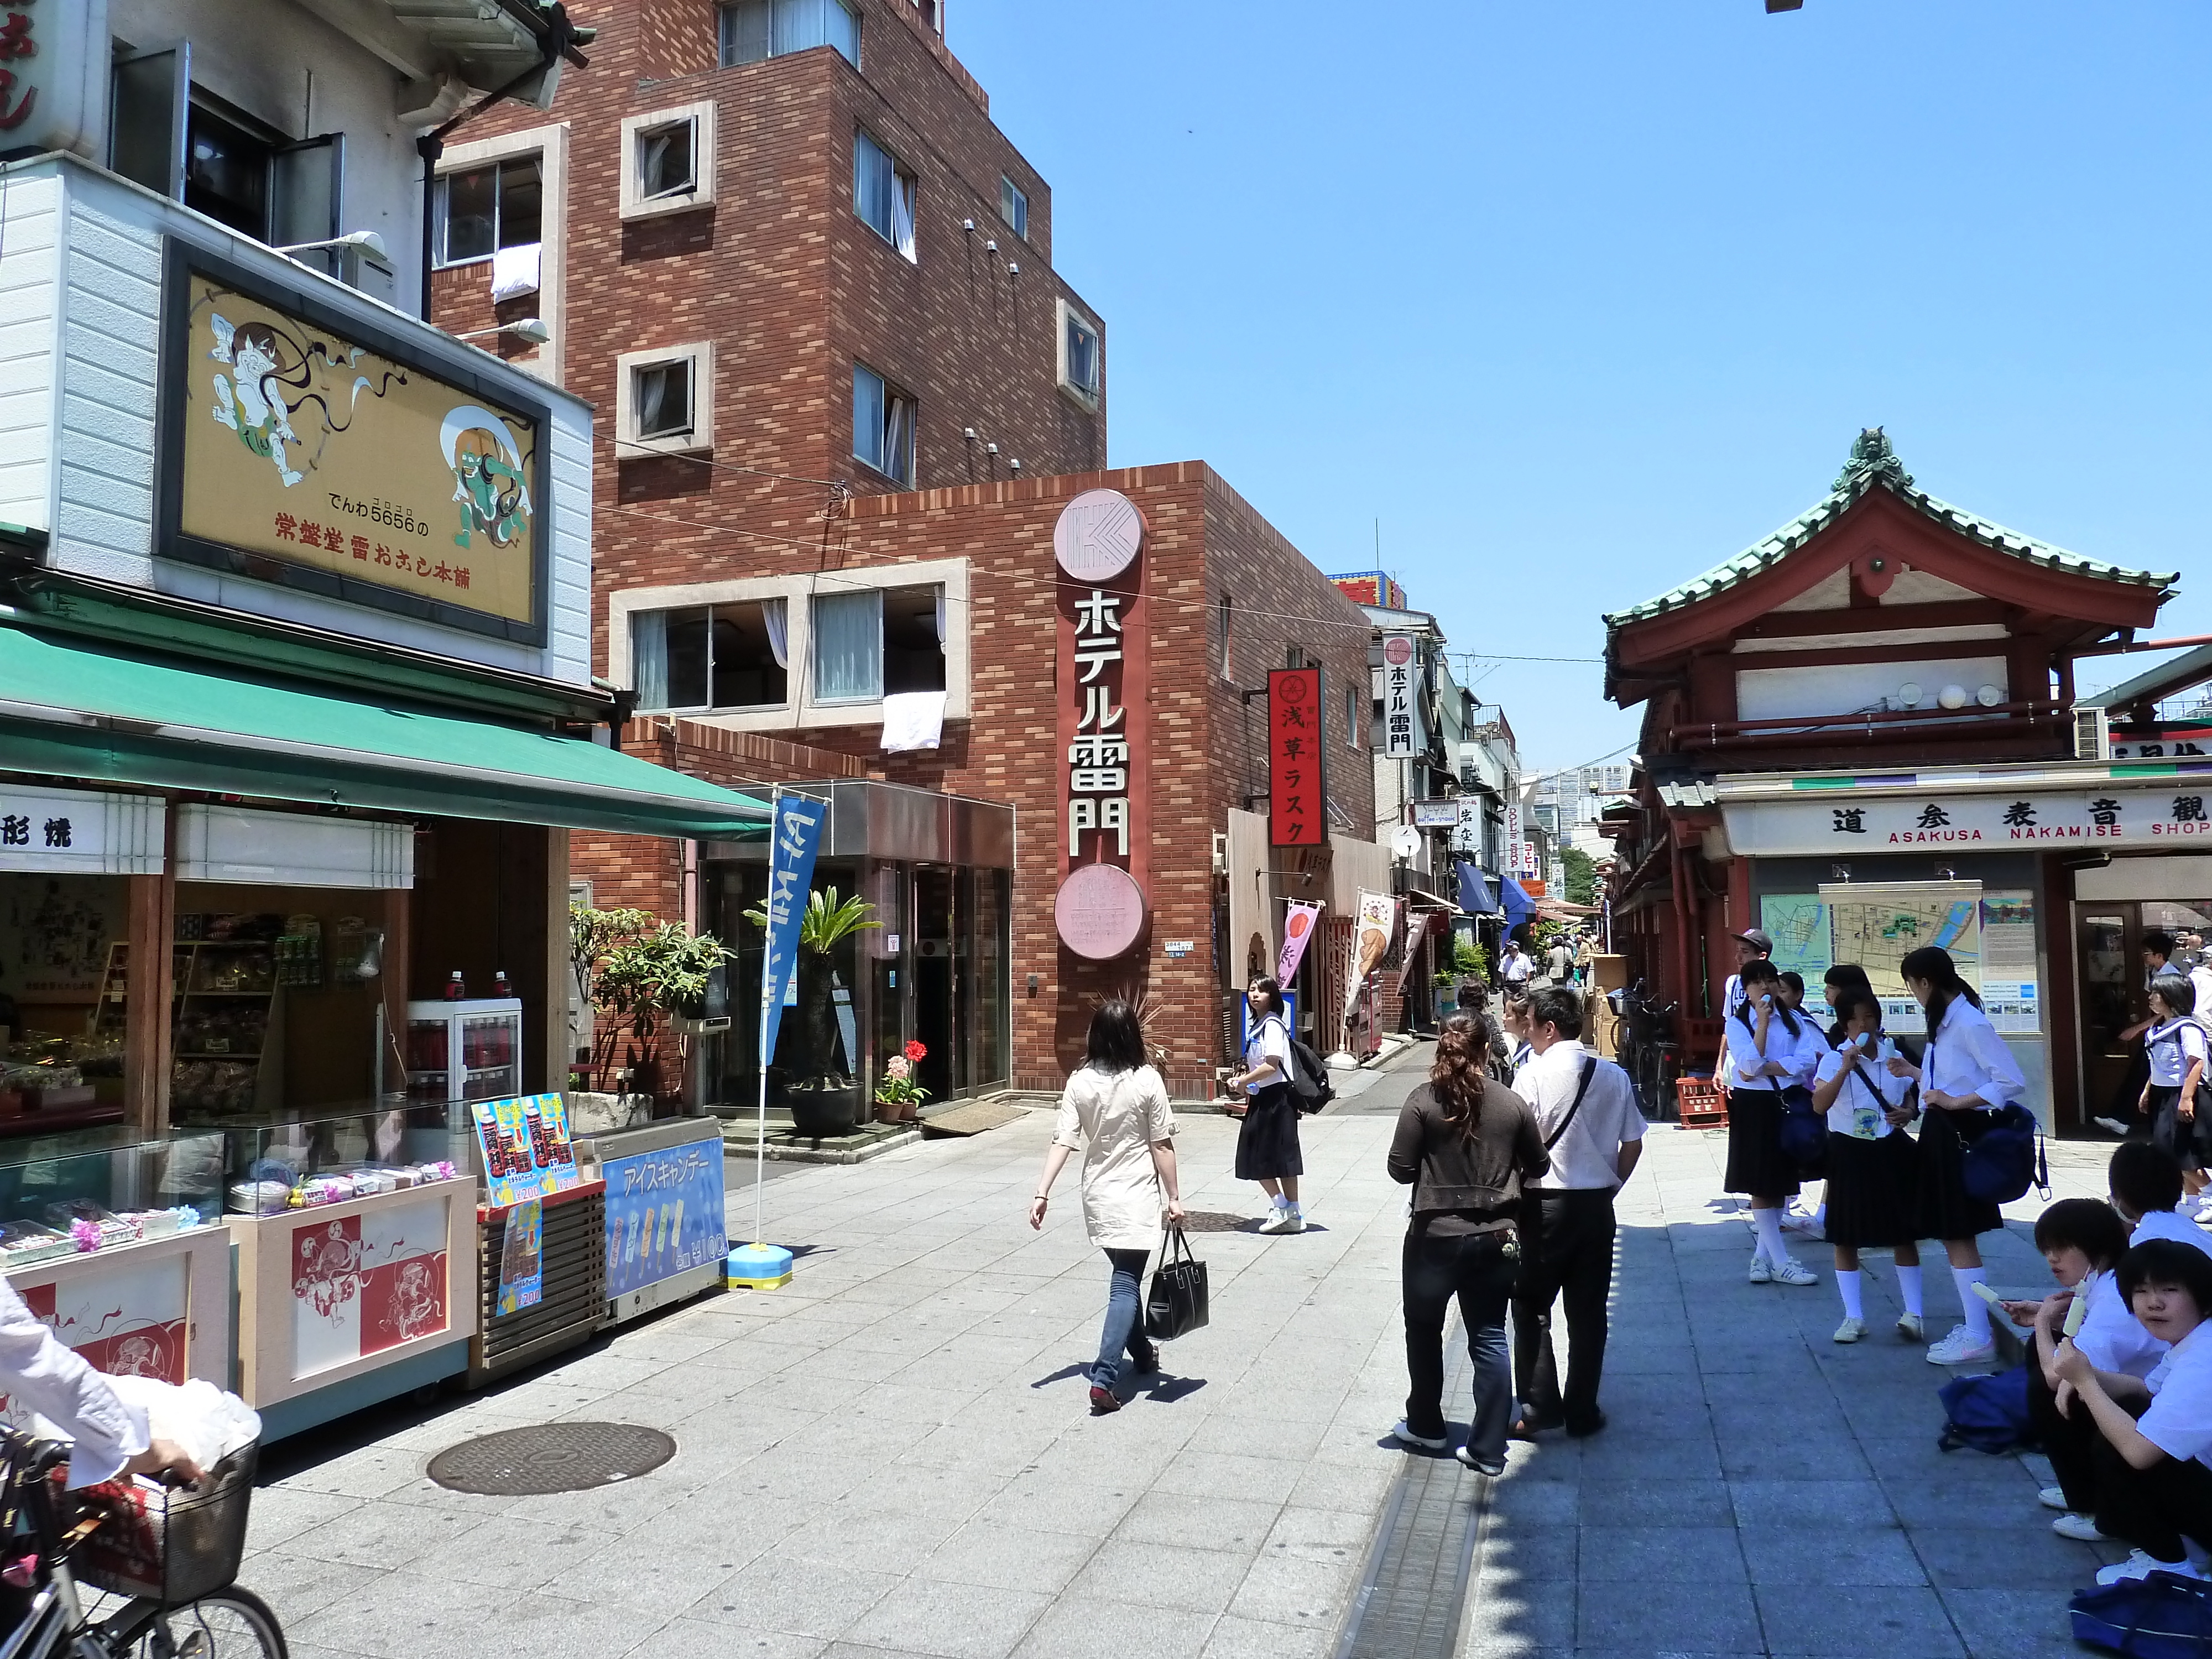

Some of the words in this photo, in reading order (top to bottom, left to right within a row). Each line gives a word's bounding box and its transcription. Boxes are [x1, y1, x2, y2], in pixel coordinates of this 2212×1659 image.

[328, 492, 429, 537] でんわ5656の
[1068, 591, 1130, 857] ホテル雷門
[1390, 667, 1410, 752] ホテル雷門
[1282, 706, 1306, 842] 浅草ラスク
[1423, 804, 1449, 814] SLOW
[1509, 808, 1519, 839] DOLL'S
[1889, 829, 1982, 844] ASAKUSA
[2010, 825, 2122, 839] NAKAMISE
[2152, 822, 2210, 834] SHOP
[1510, 843, 1519, 868] SHOP
[624, 1149, 709, 1198] アイスキャンデー
[515, 1186, 540, 1201] ¥200
[692, 1233, 725, 1264] ¥100
[517, 1290, 540, 1306] ¥200
